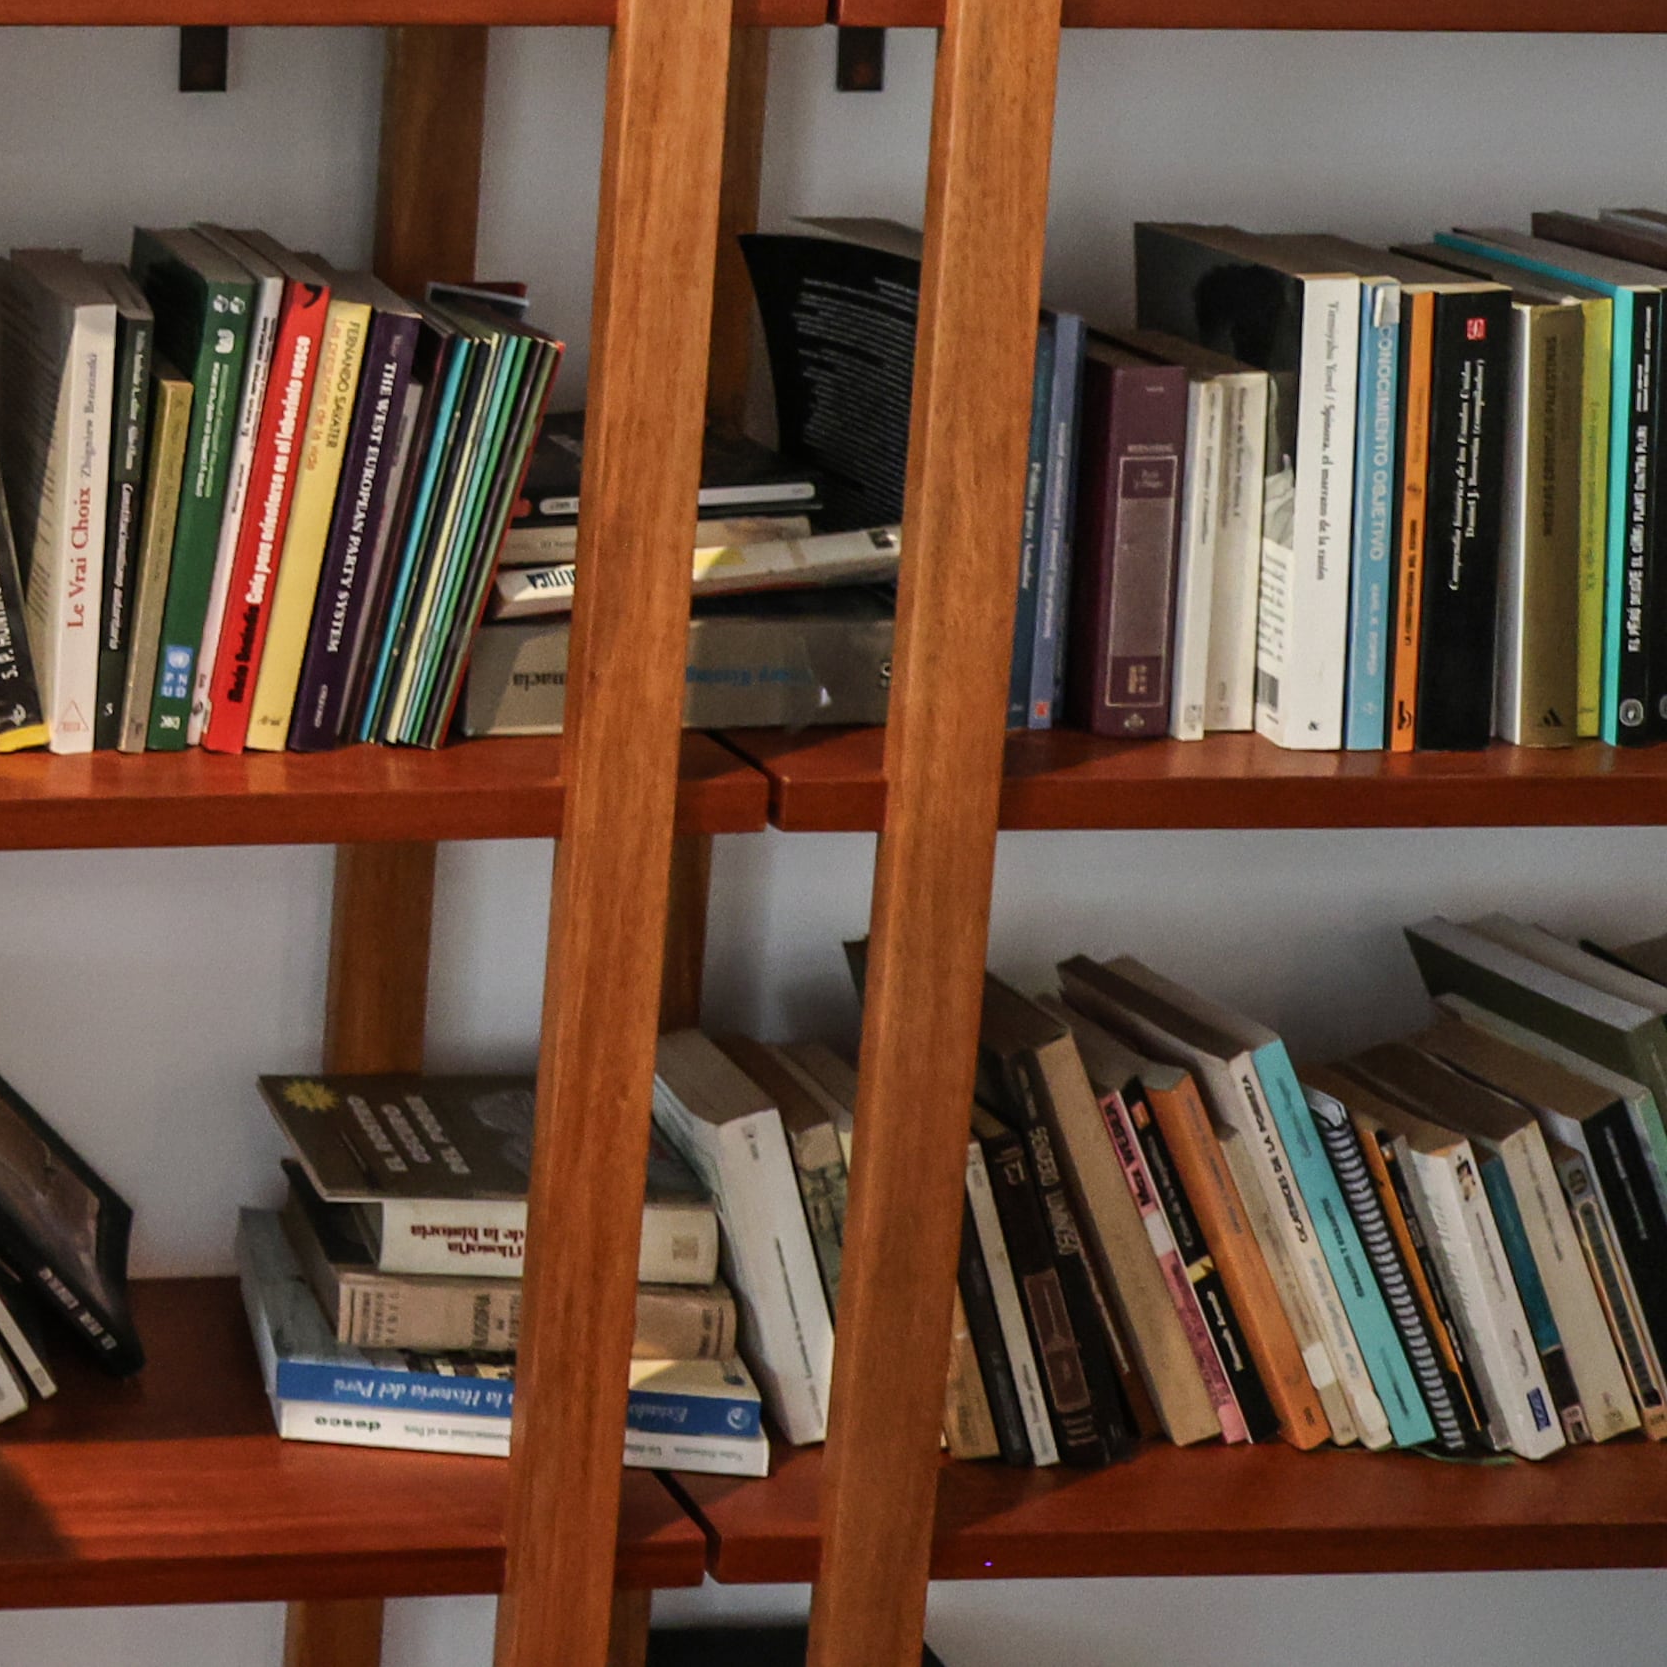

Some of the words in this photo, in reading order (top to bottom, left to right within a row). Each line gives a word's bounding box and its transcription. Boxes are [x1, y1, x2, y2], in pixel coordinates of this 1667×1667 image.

[336, 320, 360, 391] FERNANDO
[378, 361, 397, 395] THE
[1372, 326, 1395, 466] CONOCIMIENTO
[1459, 360, 1473, 398] Unidos
[325, 395, 345, 447] SAVATER
[368, 397, 389, 443] WEST
[1456, 402, 1471, 443] Estados
[1454, 446, 1466, 463] los
[1454, 465, 1466, 478] de
[350, 445, 379, 533] EUROPEAN
[71, 487, 91, 549] Choix
[1368, 470, 1388, 561] OBJETIVO
[339, 534, 361, 587] PARTY
[1447, 529, 1464, 590] Compendio
[68, 558, 87, 598] Vrai
[67, 602, 85, 627] Le
[326, 590, 350, 652] SYSTEM
[0, 664, 19, 680] S.
[1240, 1073, 1269, 1132] POBREZA
[1263, 1134, 1276, 1152] LA
[1270, 1155, 1284, 1172] DE
[411, 1223, 477, 1242] historia
[484, 1226, 499, 1241] la
[504, 1227, 524, 1242] de
[333, 1376, 374, 1398] Perú
[378, 1380, 406, 1400] del
[410, 1382, 480, 1406] Historia
[484, 1389, 503, 1407] la
